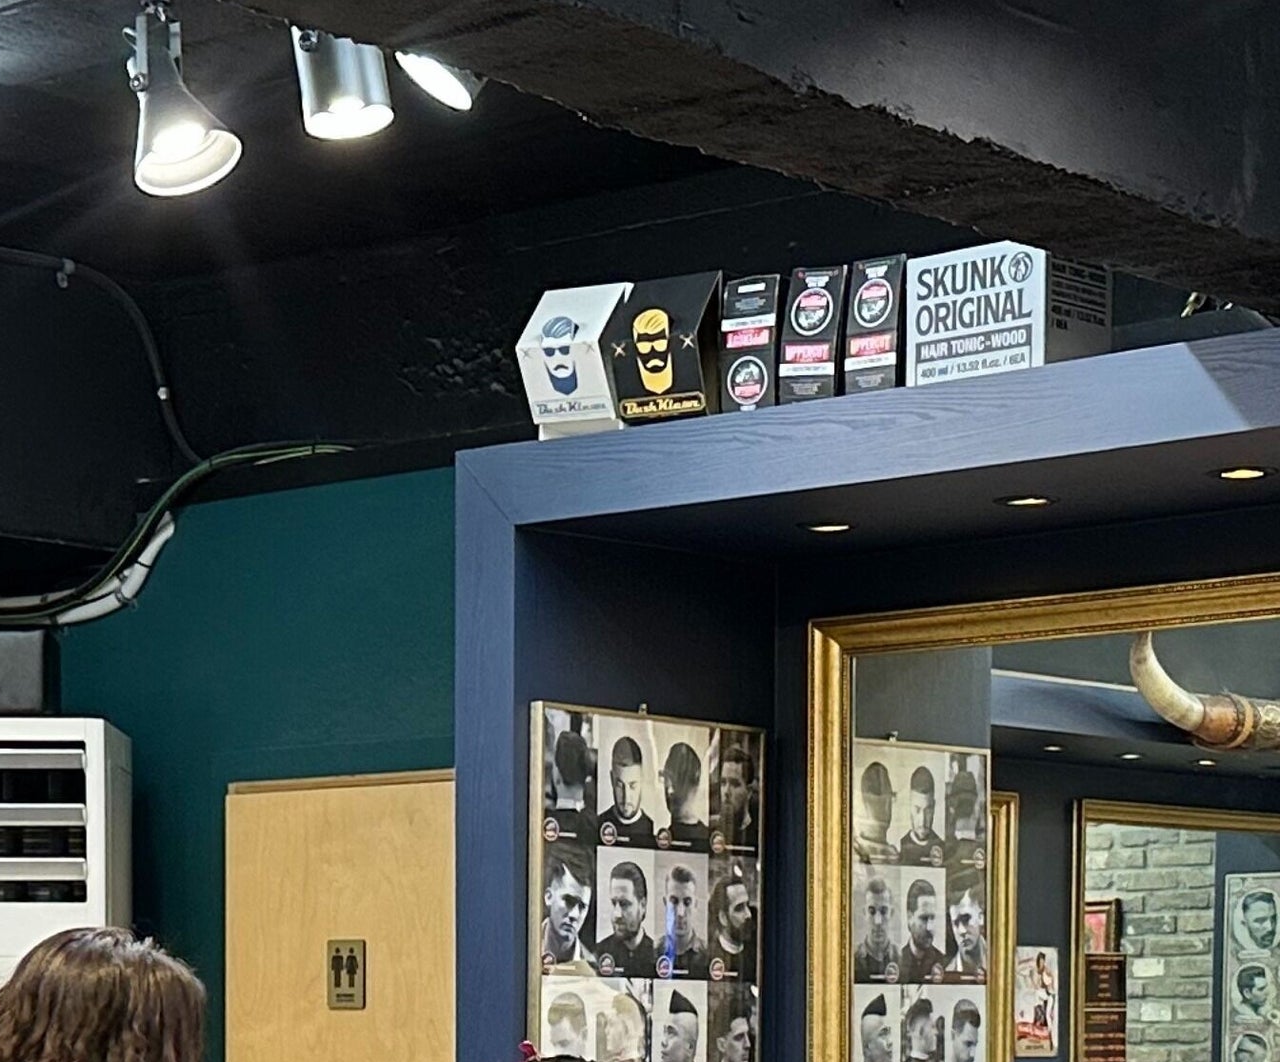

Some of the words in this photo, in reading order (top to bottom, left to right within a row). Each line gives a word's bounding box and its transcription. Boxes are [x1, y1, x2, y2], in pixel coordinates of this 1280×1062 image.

[916, 254, 1008, 302] SKUNK
[915, 288, 1033, 337] ORIGINAL
[921, 343, 949, 360] HAIR
